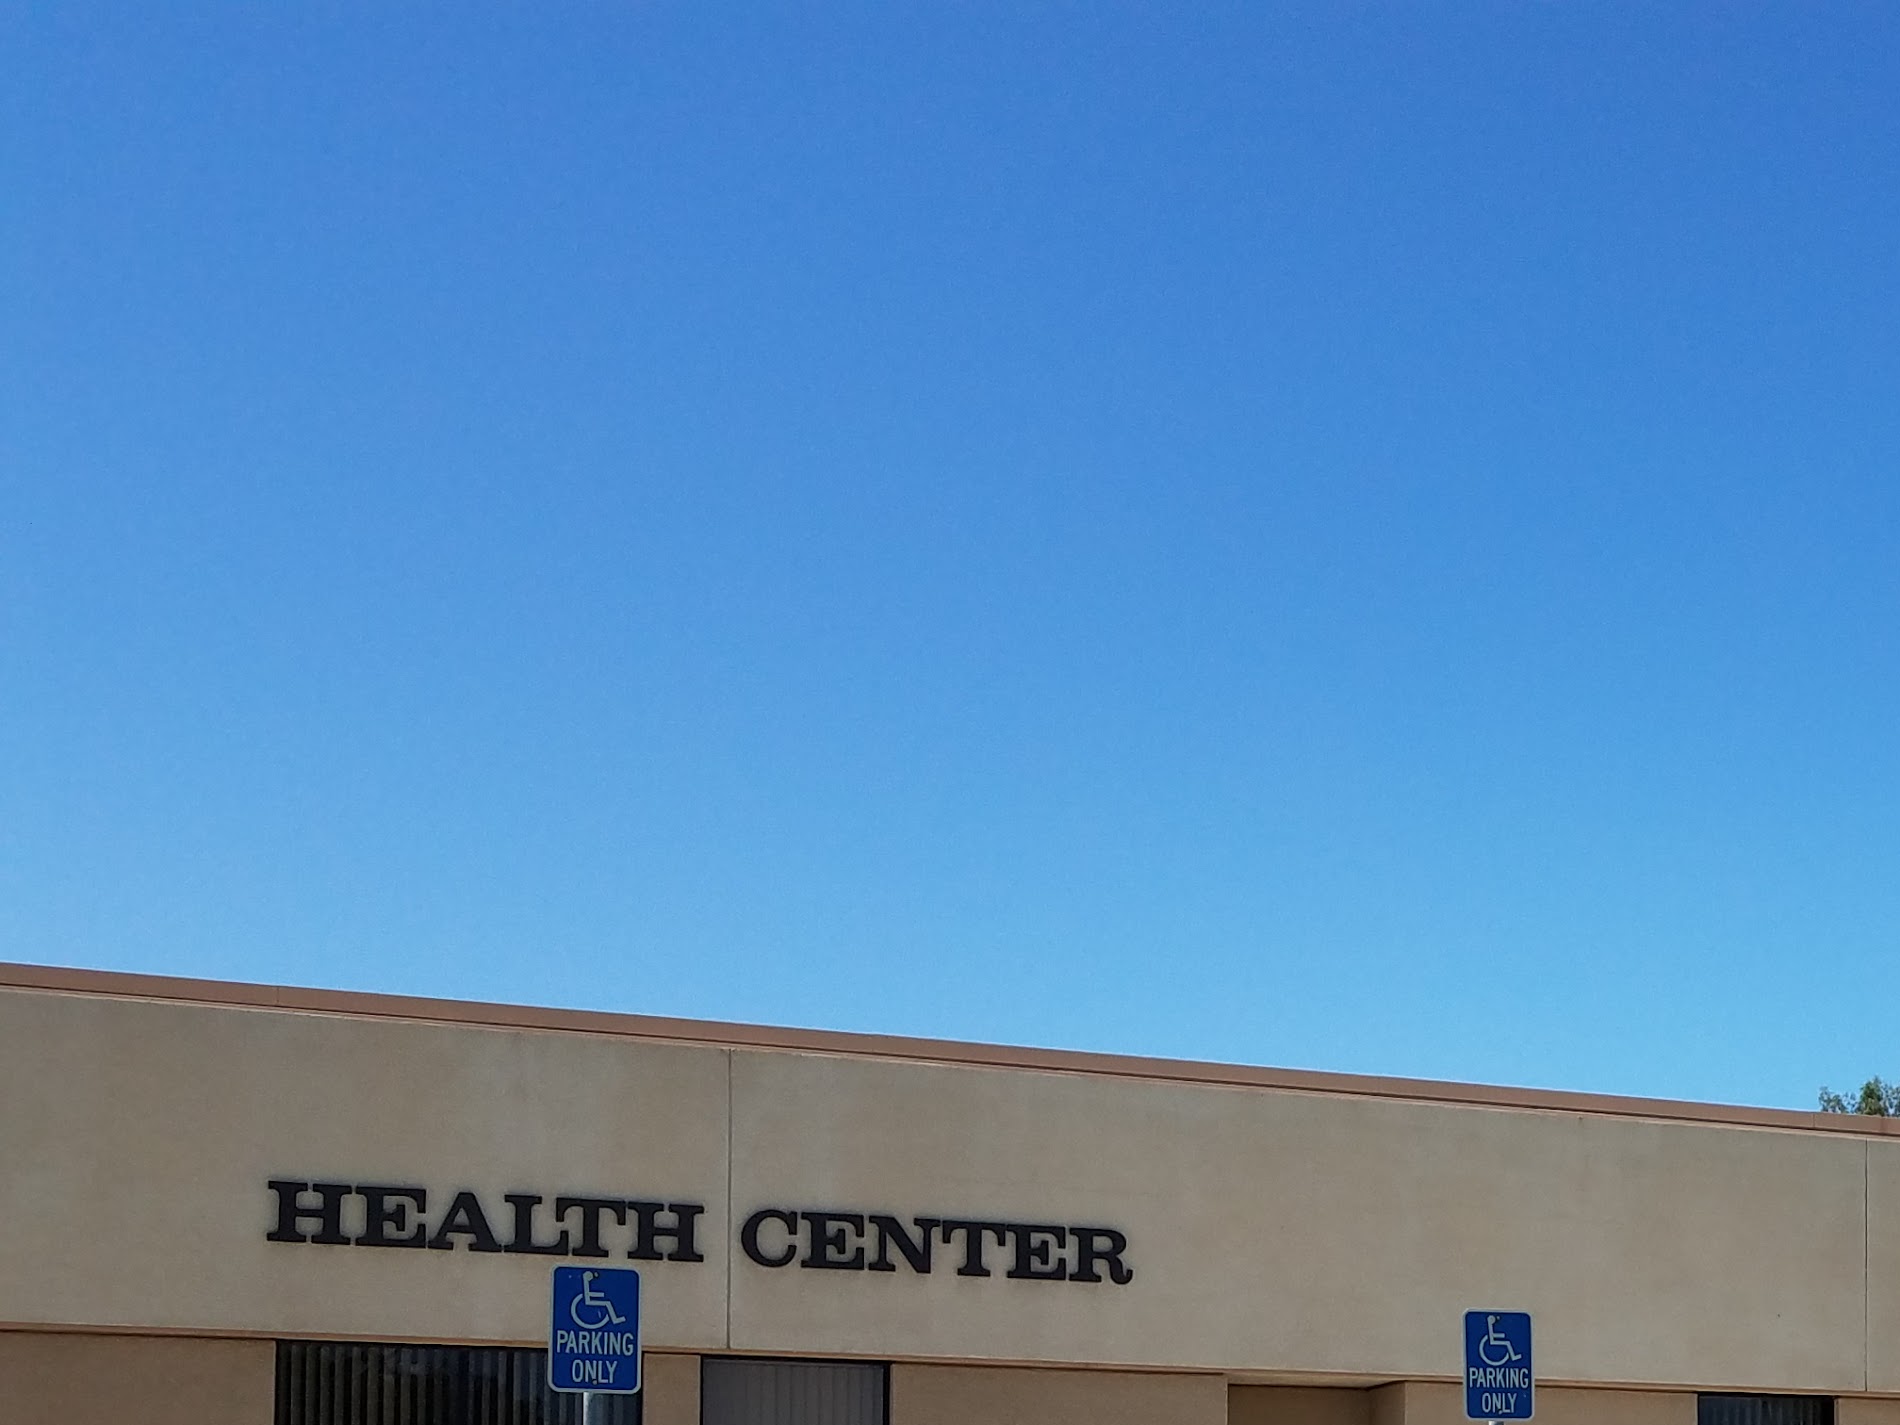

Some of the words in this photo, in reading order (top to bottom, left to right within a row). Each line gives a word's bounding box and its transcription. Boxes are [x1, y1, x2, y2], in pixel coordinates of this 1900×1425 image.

[266, 1180, 705, 1262] HEALTH
[740, 1209, 1134, 1285] CENTER
[556, 1330, 634, 1356] PARKING
[572, 1359, 618, 1384] ONLY
[1469, 1367, 1529, 1389] PARKING
[1482, 1392, 1517, 1413] ONLY
